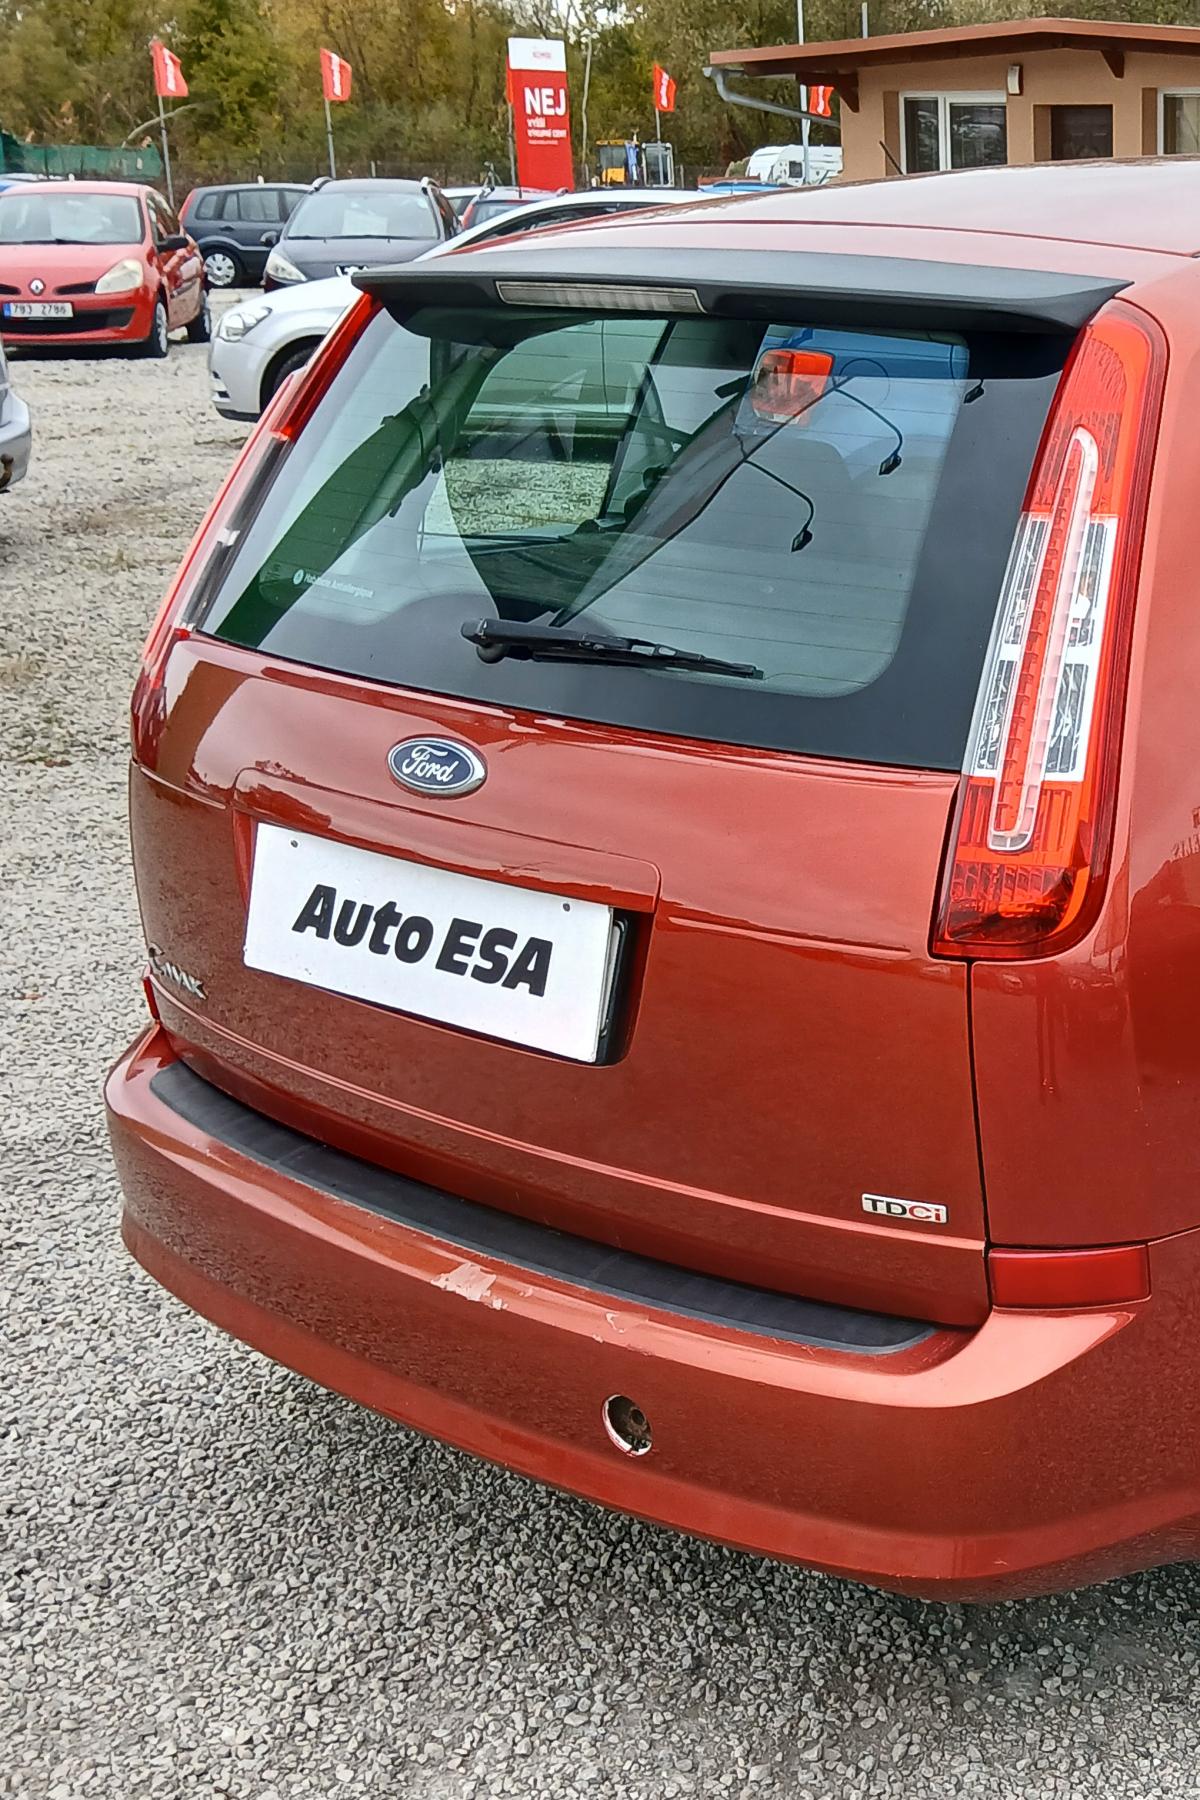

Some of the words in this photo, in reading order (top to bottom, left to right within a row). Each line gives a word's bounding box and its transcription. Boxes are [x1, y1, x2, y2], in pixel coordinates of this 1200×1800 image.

[524, 87, 567, 116] NEJ
[402, 745, 459, 782] Ford
[292, 884, 434, 963] Auto
[435, 918, 553, 997] ESA
[864, 1197, 941, 1221] TDCi
